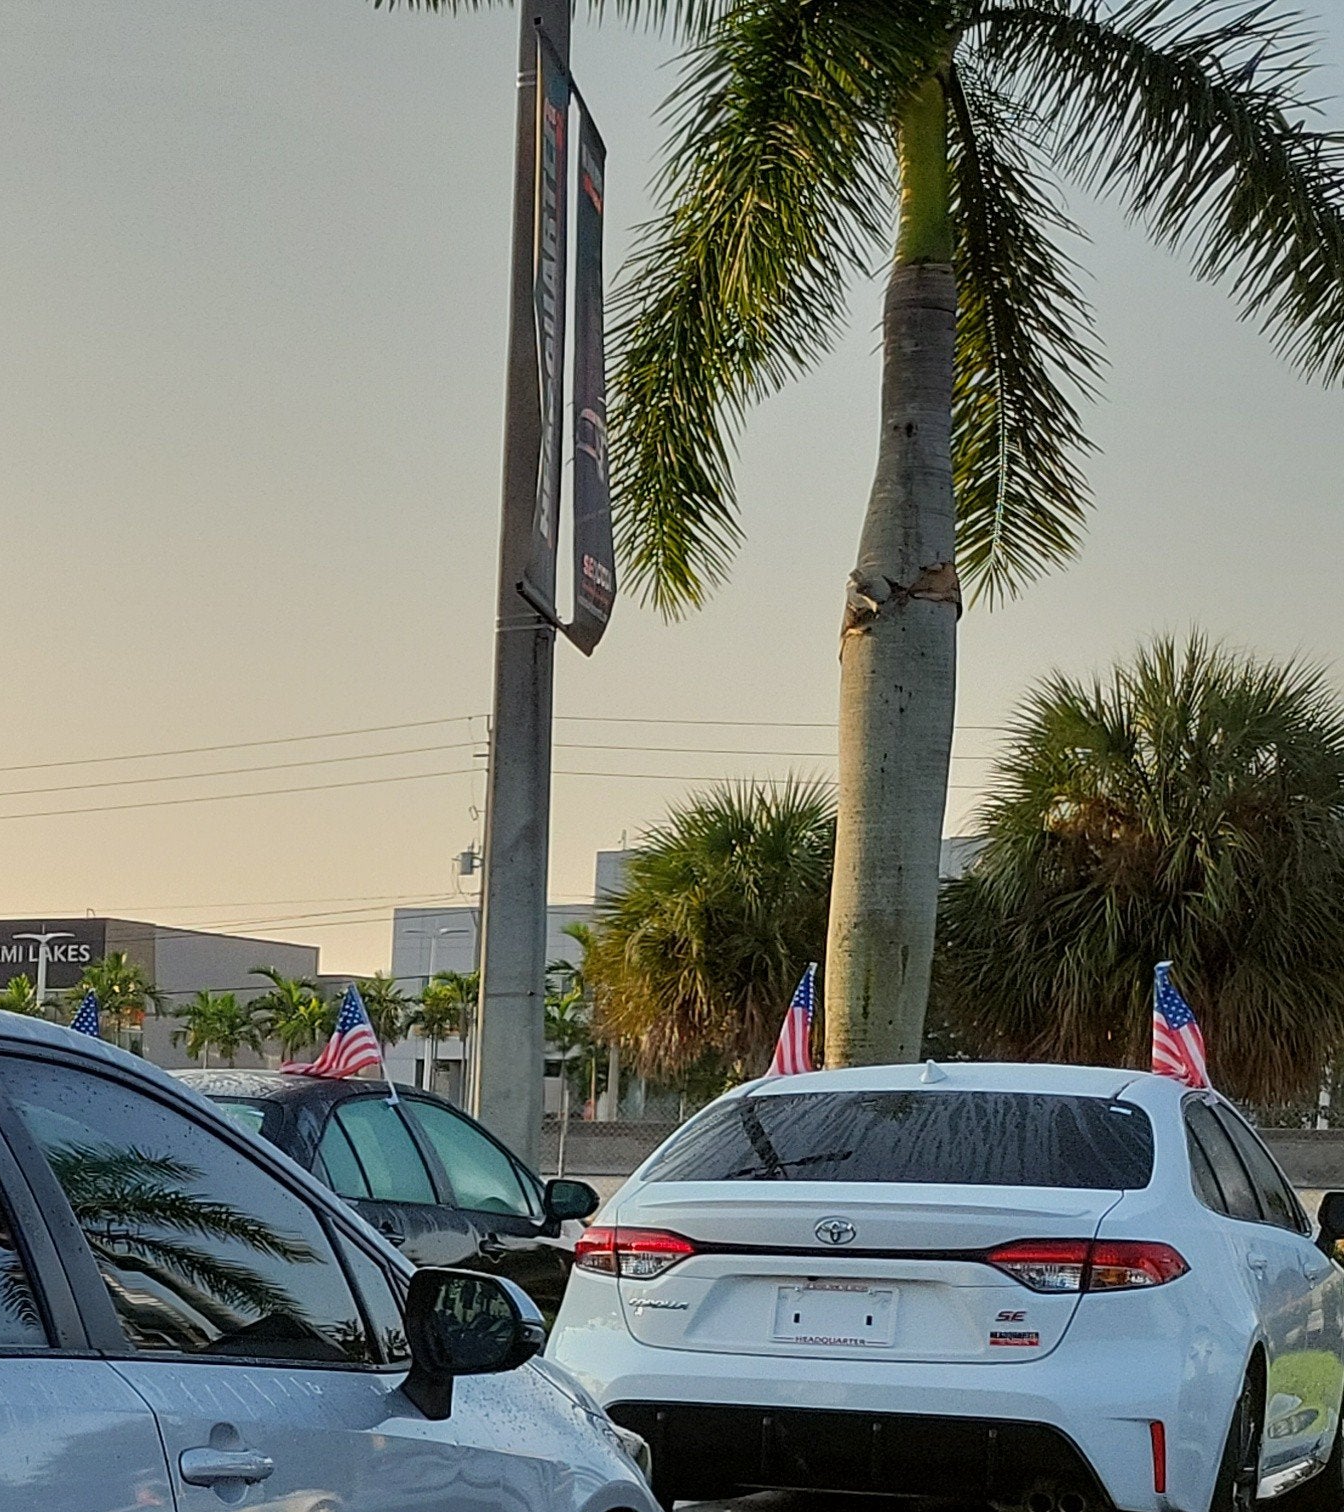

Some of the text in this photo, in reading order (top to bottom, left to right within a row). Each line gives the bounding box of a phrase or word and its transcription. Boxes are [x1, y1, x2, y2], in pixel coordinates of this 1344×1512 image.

[29, 944, 91, 962] LAKES
[995, 1310, 1028, 1322] SE
[795, 1335, 866, 1346] HEADQUARTER
